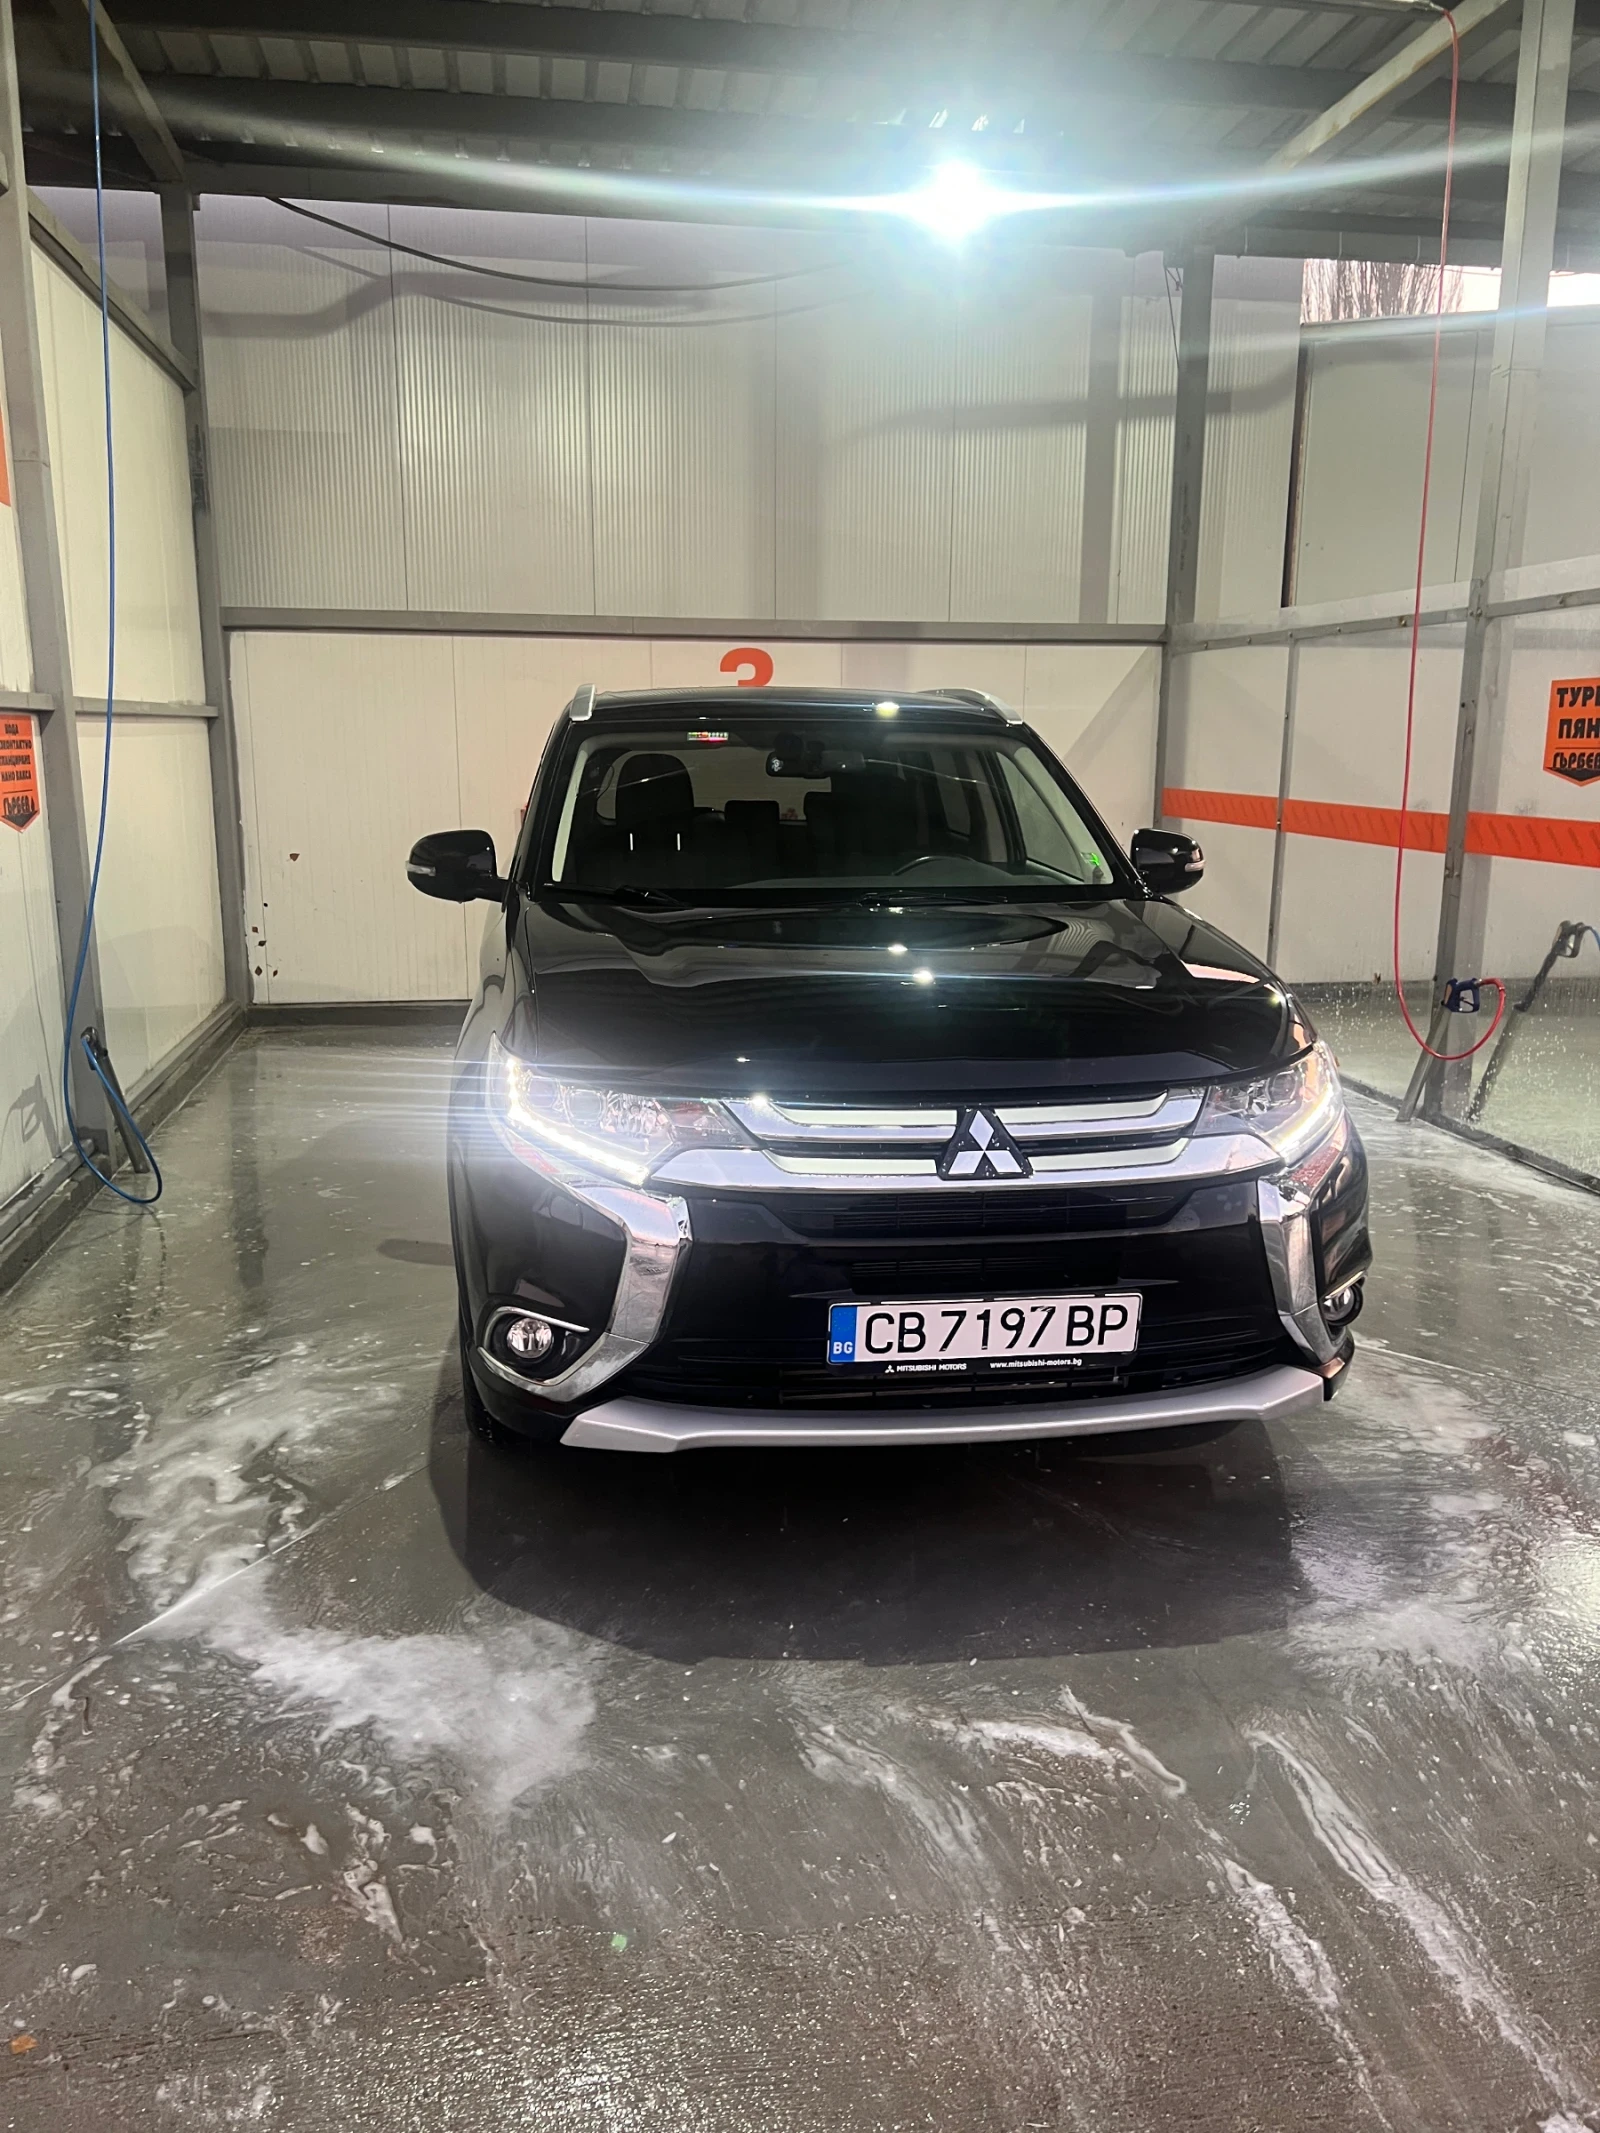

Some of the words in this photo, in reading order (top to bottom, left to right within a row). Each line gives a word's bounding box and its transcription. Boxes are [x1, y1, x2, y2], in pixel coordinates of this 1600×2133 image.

[864, 1311, 927, 1354] CB
[939, 1305, 1056, 1352] 7197
[1065, 1304, 1128, 1347] BP
[833, 1341, 853, 1355] BG
[896, 1364, 937, 1372] MITSUBISHI
[938, 1363, 967, 1371] MOTORS
[989, 1358, 1082, 1369] www.mitsubishi-motors.bg
